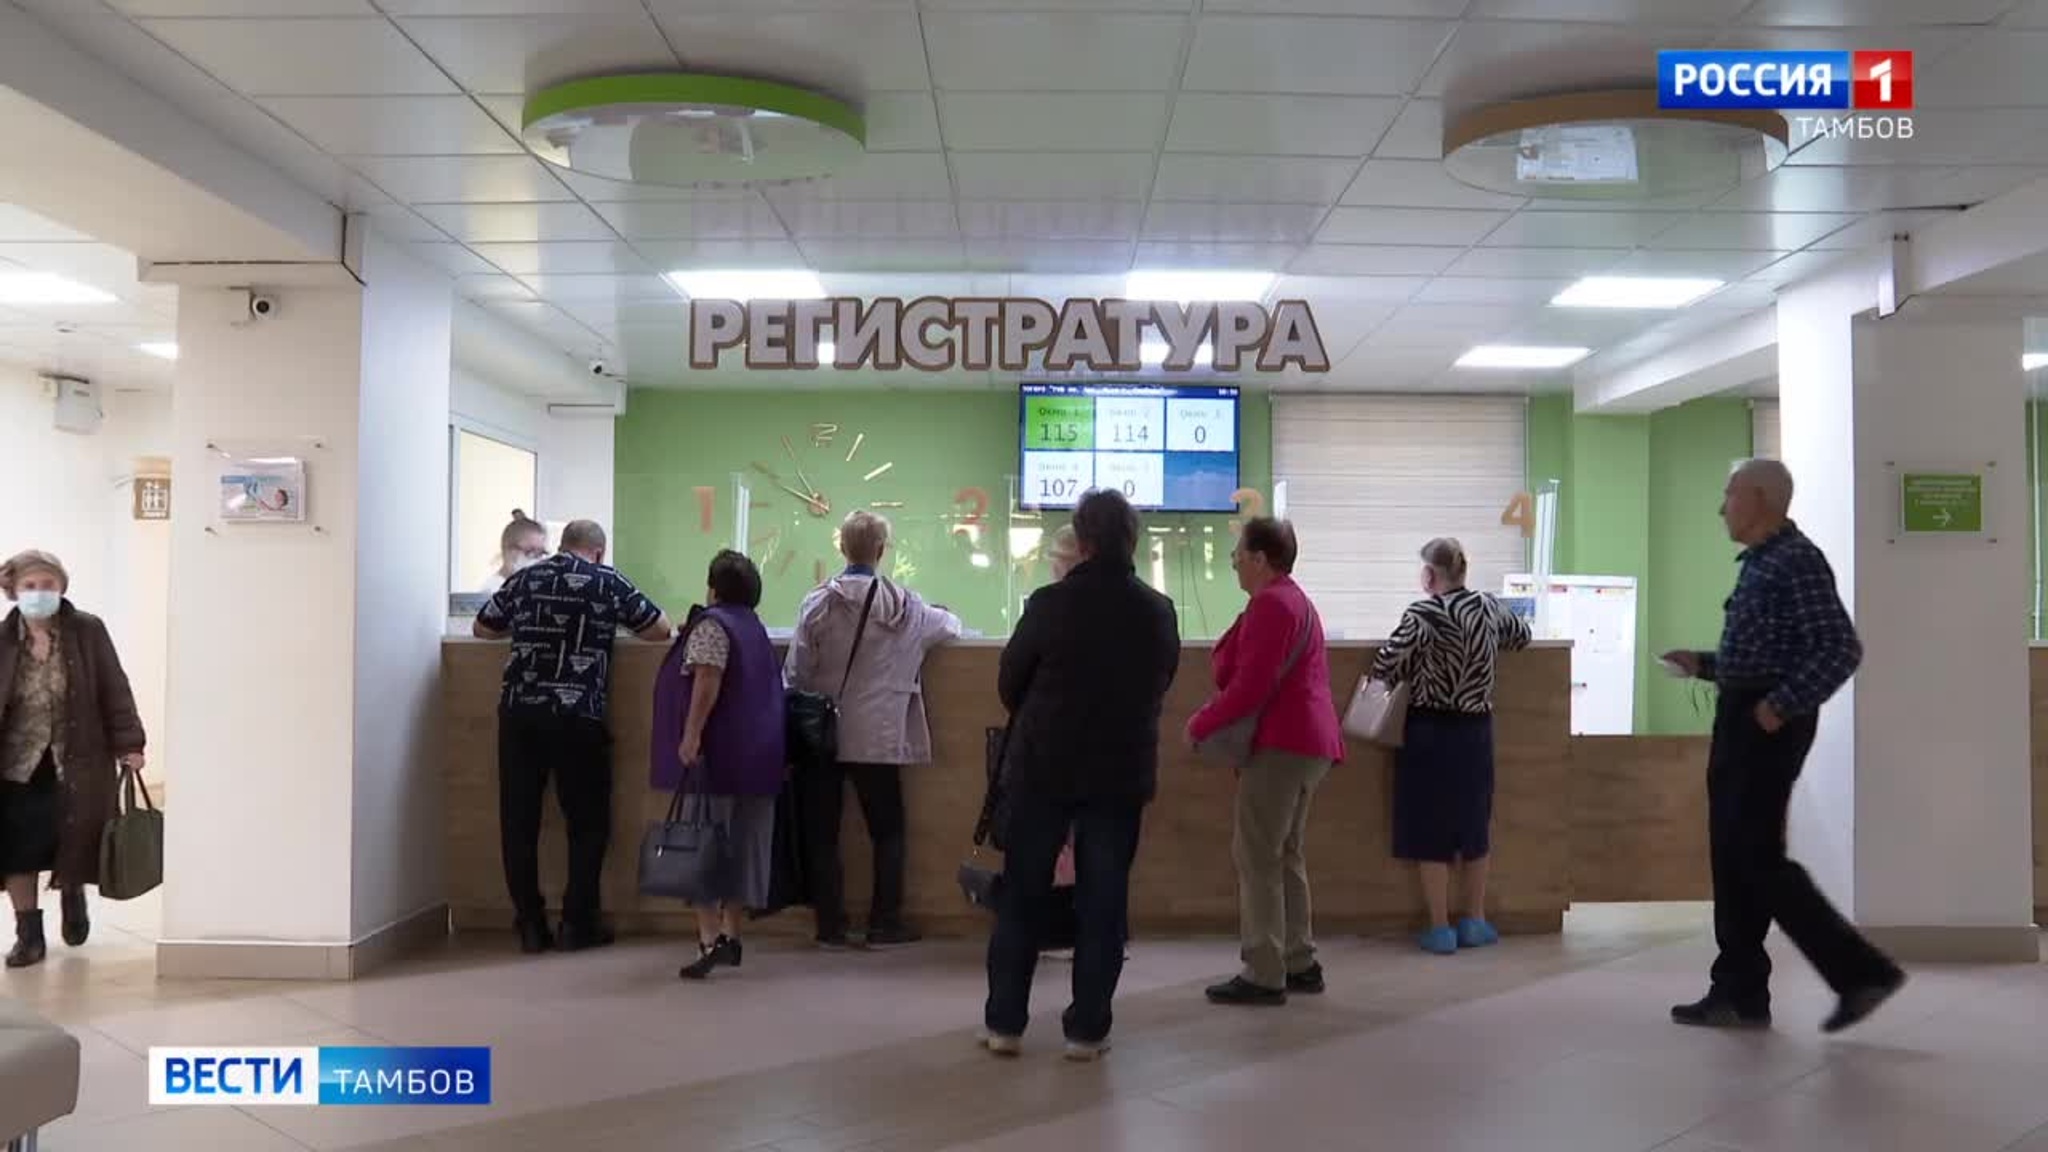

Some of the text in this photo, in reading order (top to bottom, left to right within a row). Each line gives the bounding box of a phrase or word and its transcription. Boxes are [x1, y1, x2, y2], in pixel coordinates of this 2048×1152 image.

[689, 297, 1331, 372] РЕГИСТРАТУРА
[1040, 423, 1078, 442] 115
[1113, 423, 1149, 442] 114
[1194, 425, 1206, 444] 0
[1040, 479, 1078, 497] 107
[1124, 479, 1136, 498] 0
[692, 486, 715, 534] 1
[1501, 493, 1536, 538] 4
